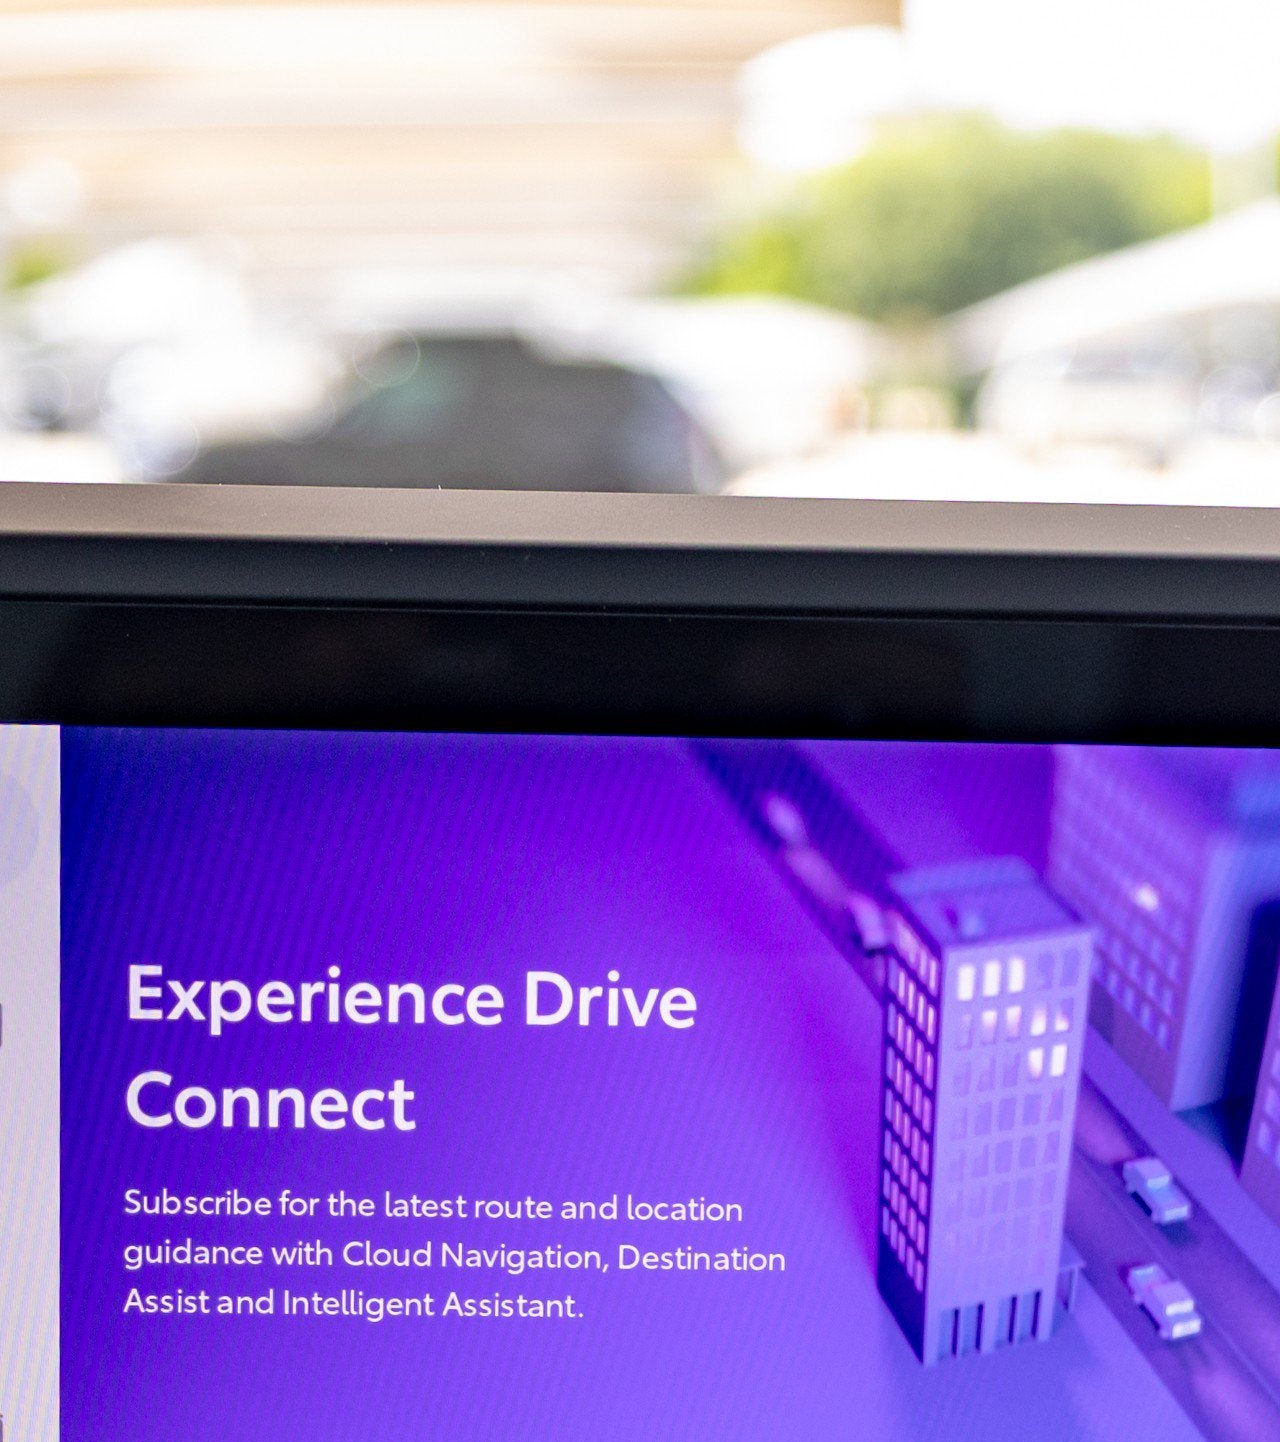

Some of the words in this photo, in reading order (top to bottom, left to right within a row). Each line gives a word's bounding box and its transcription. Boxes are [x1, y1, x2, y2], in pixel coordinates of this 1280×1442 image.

[128, 964, 504, 1036] Experience
[526, 970, 696, 1029] Drive
[126, 1071, 416, 1131] Connect
[125, 1189, 271, 1217] Subscribe
[279, 1190, 319, 1217] for
[328, 1191, 375, 1218] the
[384, 1192, 466, 1219] latest
[474, 1195, 552, 1221] route
[561, 1195, 618, 1221] and
[628, 1195, 742, 1222] location
[124, 1239, 263, 1270] guidance
[271, 1240, 332, 1266] with
[343, 1241, 432, 1268] Cloud
[441, 1242, 609, 1274] Navigation,
[619, 1244, 786, 1272] Destination
[124, 1288, 209, 1314] Assist
[217, 1289, 274, 1315] and
[284, 1289, 434, 1322] Intelligent
[442, 1292, 584, 1319] Assistant.
